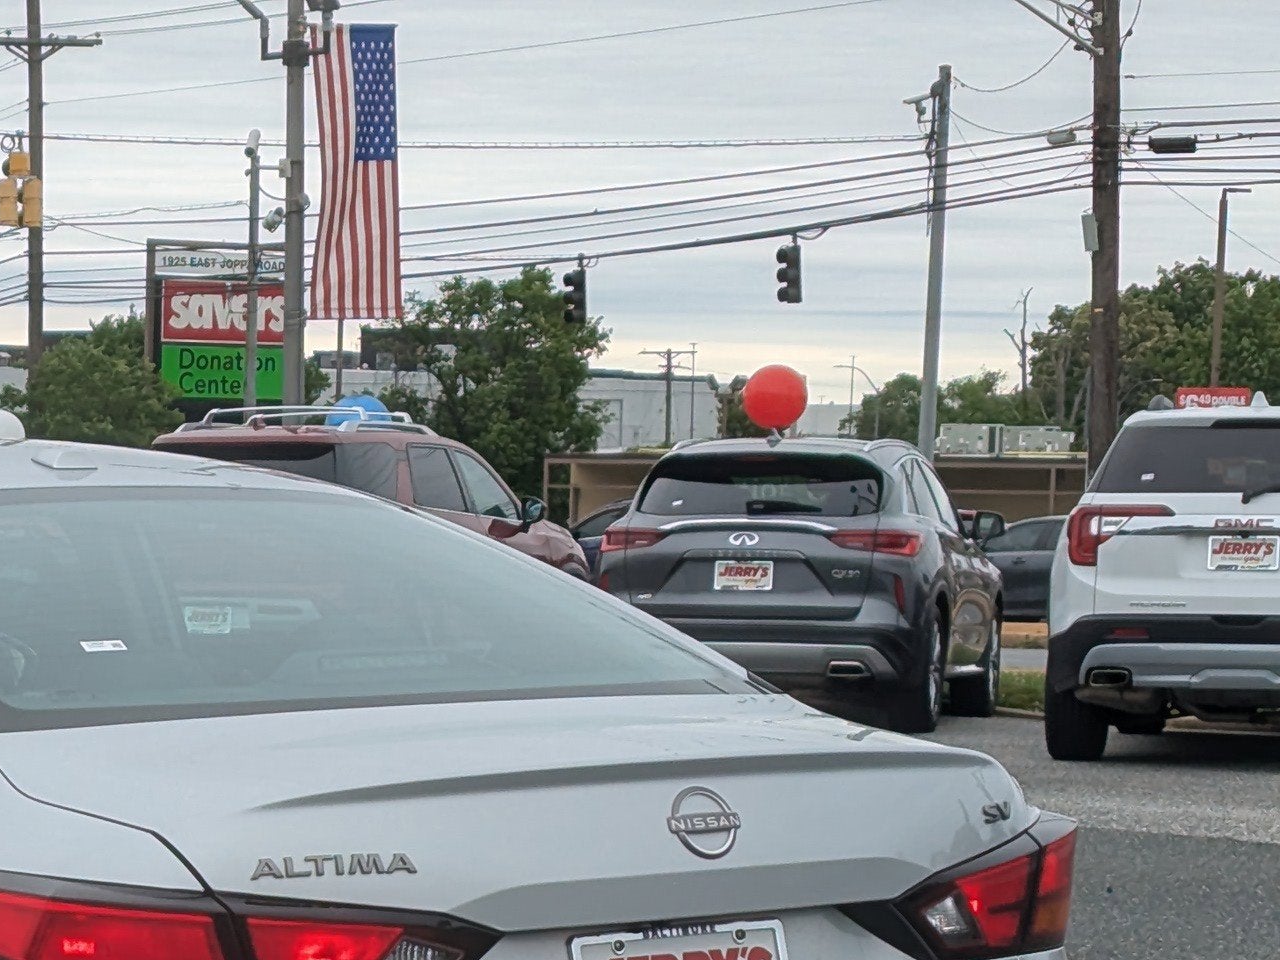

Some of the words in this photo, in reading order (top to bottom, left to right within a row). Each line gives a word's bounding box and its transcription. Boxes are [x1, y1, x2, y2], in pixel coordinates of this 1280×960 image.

[162, 256, 187, 267] 1925
[190, 257, 217, 268] EAST
[221, 258, 250, 269] JOPP
[179, 348, 276, 372] Donaton
[179, 372, 247, 394] Cente
[1213, 518, 1275, 529] GMC
[1212, 541, 1276, 556] JERRY'S
[718, 565, 769, 578] JERRY'S
[981, 801, 1011, 825] SV
[671, 815, 741, 831] NISSAN
[250, 852, 418, 881] ALTIMA
